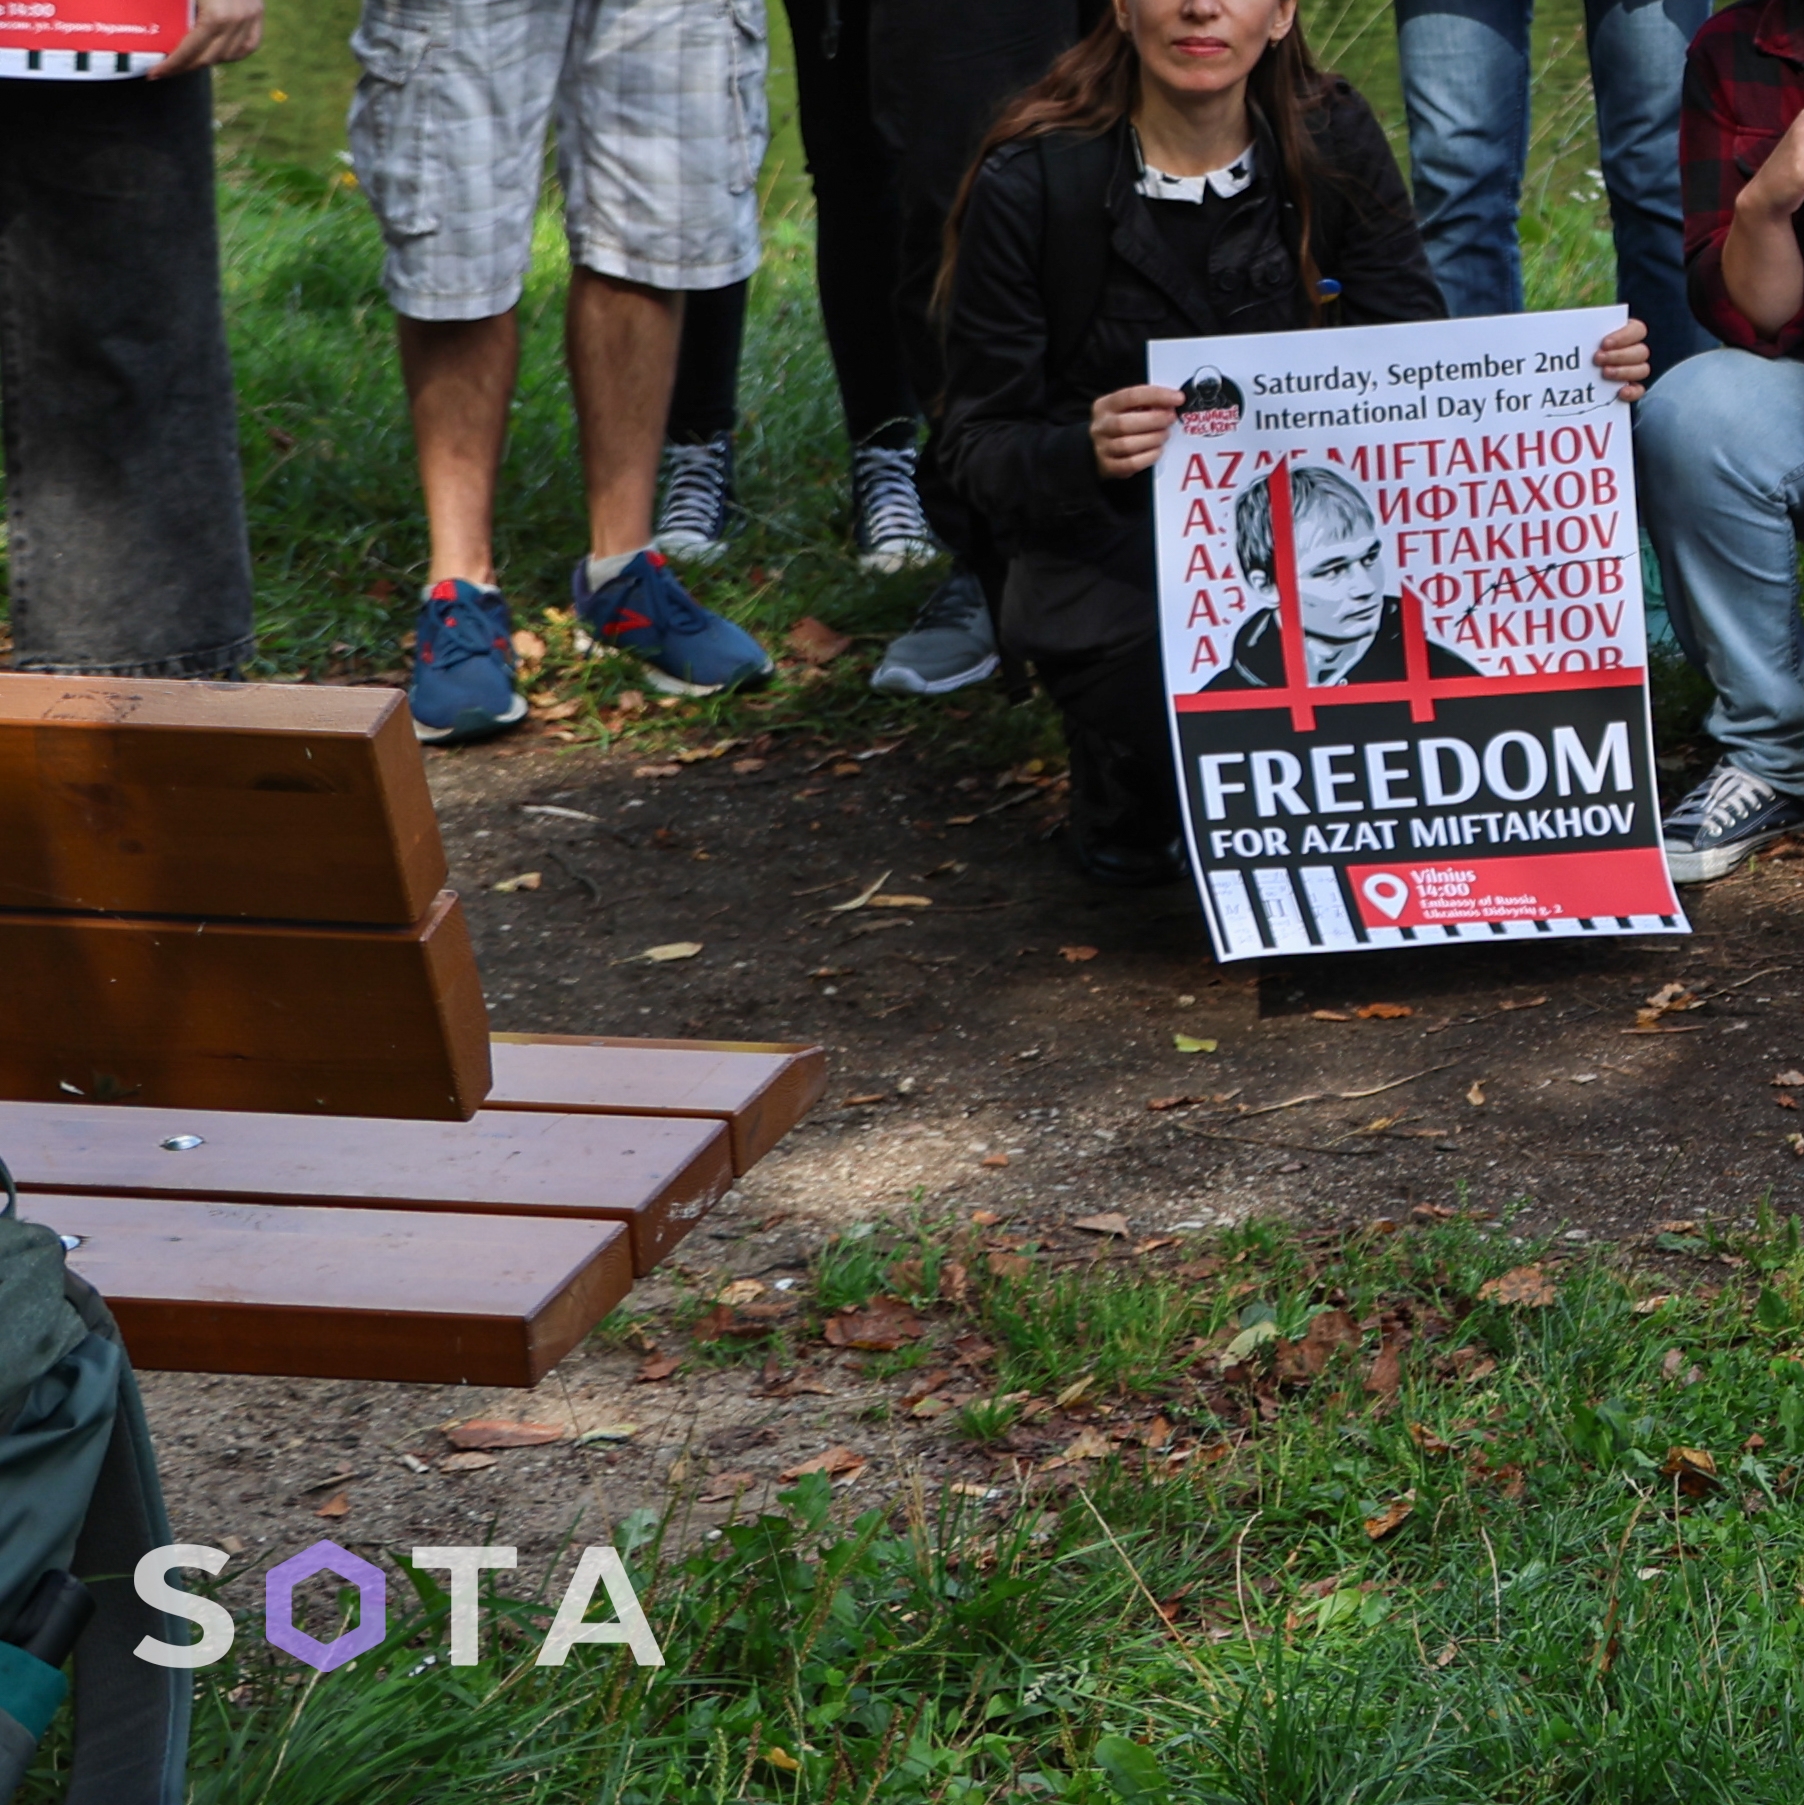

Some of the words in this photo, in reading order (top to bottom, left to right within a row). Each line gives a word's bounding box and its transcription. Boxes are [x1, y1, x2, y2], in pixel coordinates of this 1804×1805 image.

[1253, 366, 1377, 395] Saturday,
[1387, 353, 1524, 389] September
[1535, 347, 1579, 372] 2nd
[1255, 395, 1427, 430] International
[1437, 396, 1486, 422] Day
[1494, 388, 1532, 412] for
[1540, 383, 1595, 408] Azat
[1198, 721, 1632, 820] FREEDOM
[1210, 827, 1290, 857] FOR
[1302, 819, 1398, 854] AZAT
[1410, 801, 1634, 848] MIFTAKHOV
